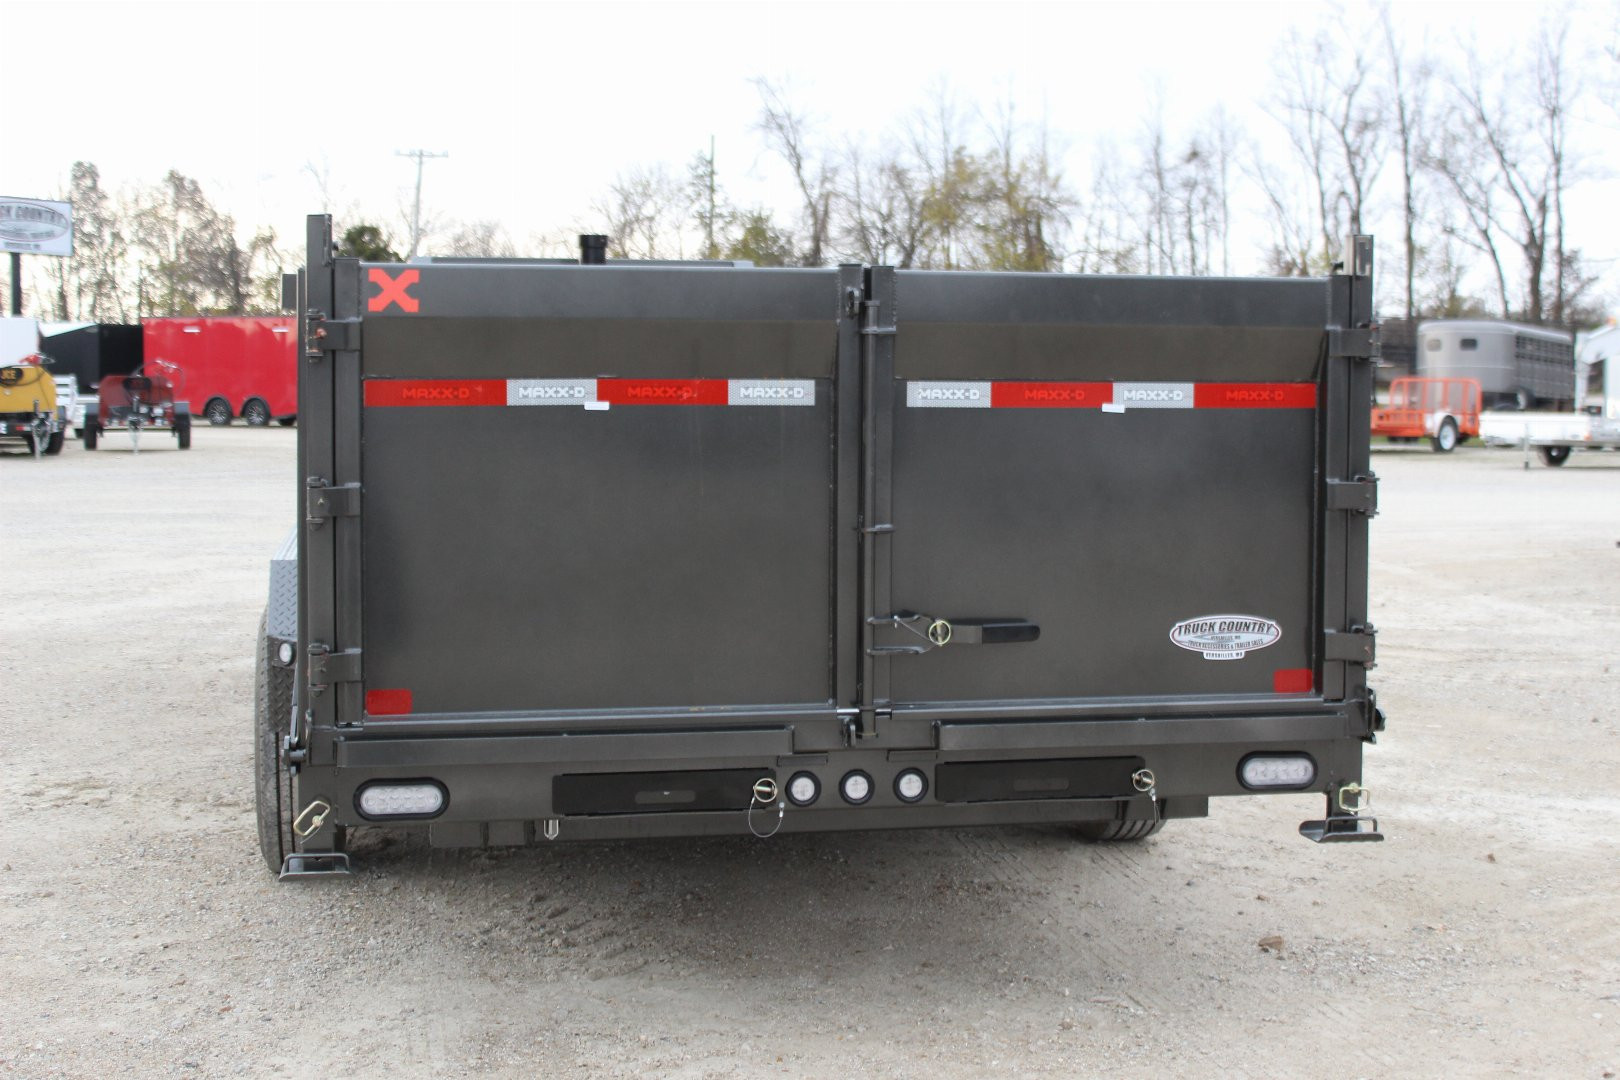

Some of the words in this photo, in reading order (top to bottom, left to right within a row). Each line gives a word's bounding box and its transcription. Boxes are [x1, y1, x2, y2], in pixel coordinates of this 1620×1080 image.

[402, 387, 470, 399] MAXX-D
[518, 386, 585, 399] MAXX-D
[739, 387, 804, 398] MAXX-D
[918, 389, 980, 400] MAXX-D
[1024, 389, 1085, 401] MAXX-D
[1123, 390, 1183, 401] MAXX-D
[1177, 621, 1216, 636] TRUCK
[1218, 620, 1273, 634] COUNTRY
